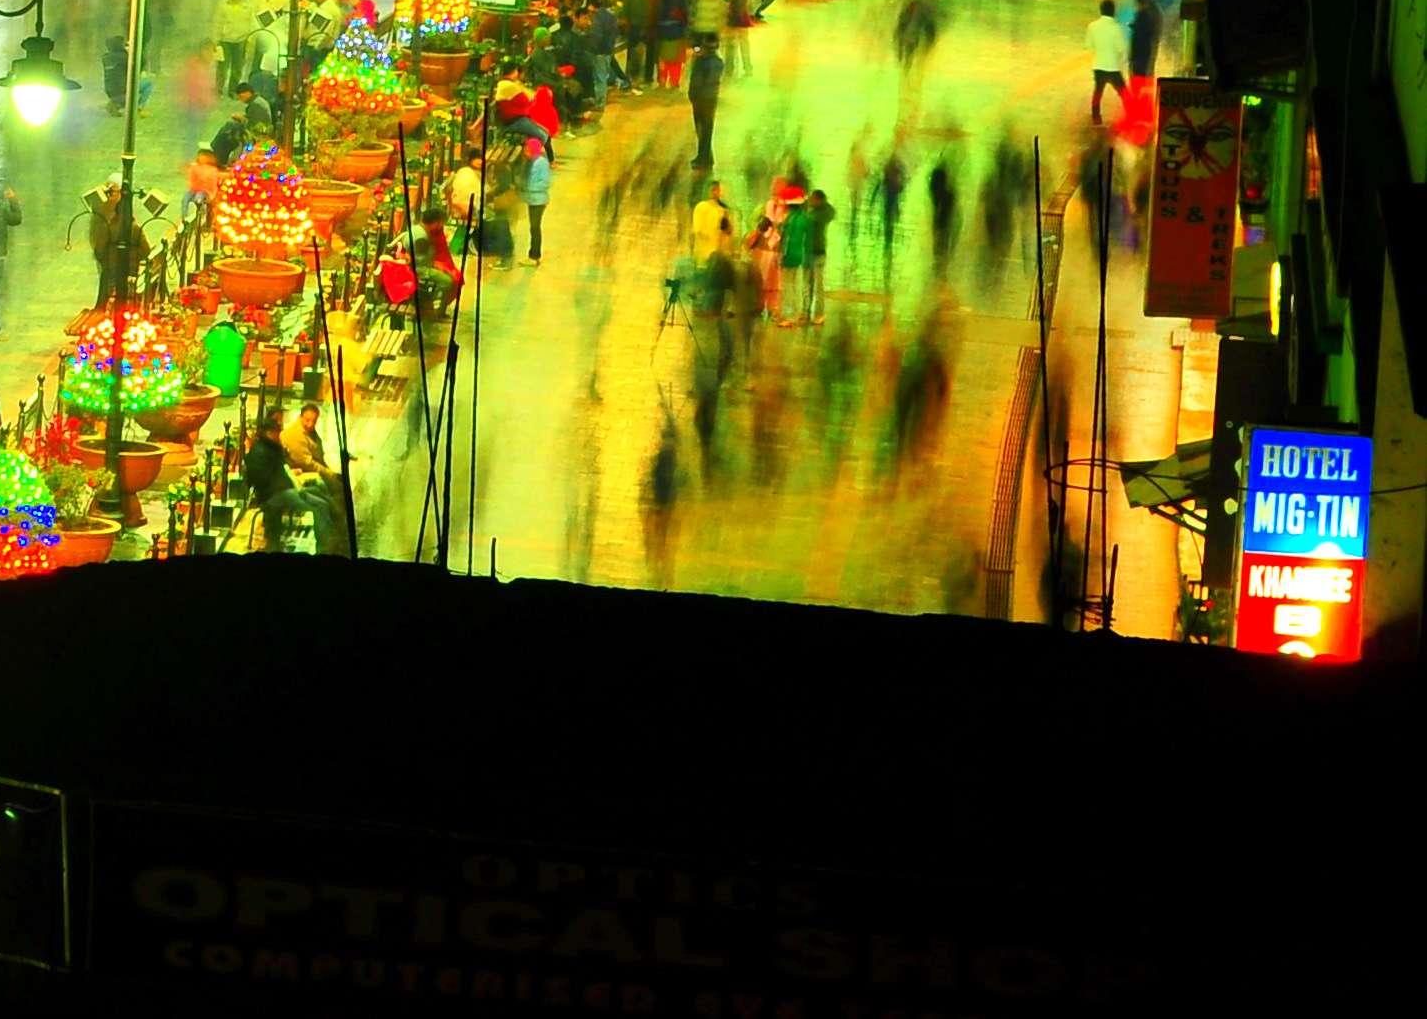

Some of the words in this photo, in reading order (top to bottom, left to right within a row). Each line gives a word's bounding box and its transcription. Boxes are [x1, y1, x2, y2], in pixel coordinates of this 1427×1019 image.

[1187, 205, 1205, 223] &
[1260, 444, 1358, 481] HOTEL
[129, 862, 731, 970] OPTICAL
[772, 923, 1157, 1002] SHOP
